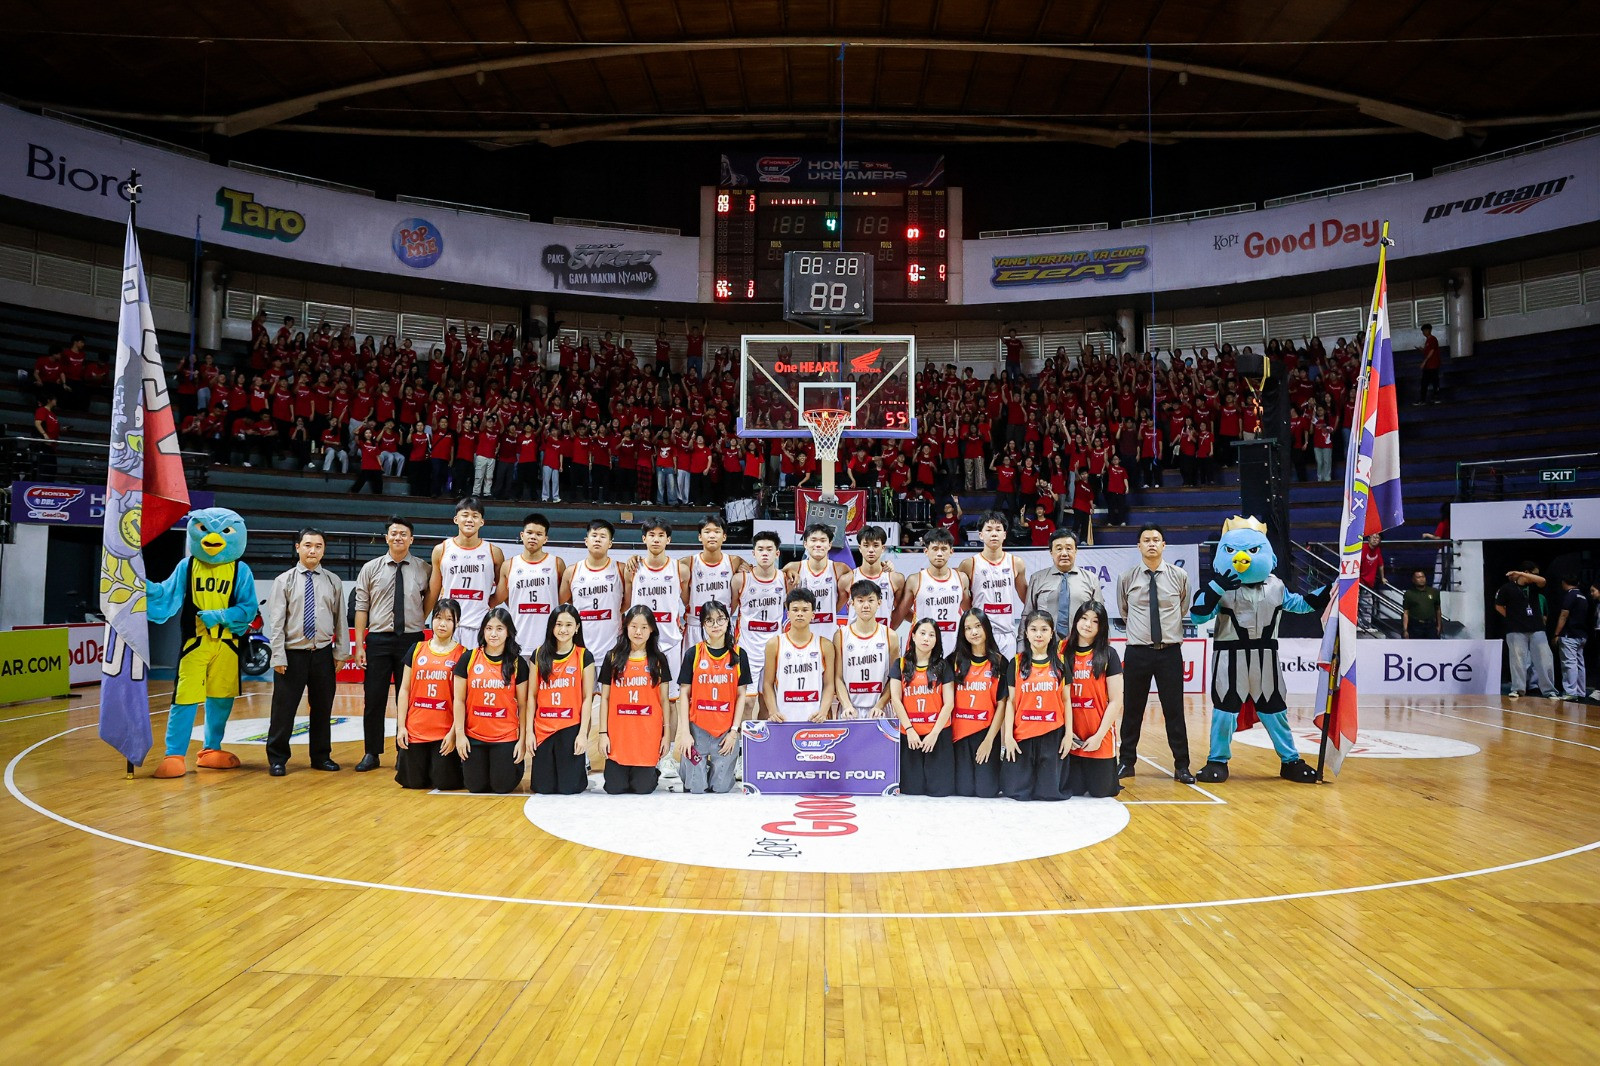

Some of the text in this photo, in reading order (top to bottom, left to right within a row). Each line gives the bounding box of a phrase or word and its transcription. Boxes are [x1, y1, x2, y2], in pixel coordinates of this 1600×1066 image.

[808, 160, 859, 170] HOME
[808, 171, 908, 180] DREAMERS
[718, 195, 729, 204] 00
[1422, 176, 1568, 224] proteam
[218, 188, 305, 238] Taro
[718, 204, 729, 212] 03
[826, 219, 836, 231] 4
[400, 226, 427, 246] POP
[907, 228, 945, 238] 07 0
[1244, 223, 1315, 260] Good
[1322, 218, 1380, 248] Day
[406, 239, 438, 258] MIE
[547, 254, 565, 264] PAKE
[568, 249, 662, 270] STREET
[994, 257, 1026, 267] YANG
[1029, 254, 1072, 265] WORTH
[1094, 250, 1110, 260] YA
[1111, 248, 1145, 258] CUMA
[910, 264, 918, 272] 17
[569, 273, 588, 284] GAYA
[590, 272, 616, 284] MAKIN
[716, 280, 727, 289] 22
[774, 361, 797, 373] One
[1542, 471, 1573, 481] EXIT
[1522, 502, 1573, 521] AQUA
[462, 577, 471, 588] 77
[529, 591, 538, 602] 15
[995, 592, 1001, 603] 13
[593, 598, 598, 609] 8
[652, 599, 657, 610] 3
[761, 610, 767, 621] 11
[938, 608, 947, 620] 22
[1, 656, 61, 676] AR.COM
[1384, 654, 1472, 682] Bioré
[860, 669, 870, 681] 19
[798, 678, 805, 690] 17
[1073, 682, 1082, 696] 77
[428, 684, 437, 697] 15
[629, 690, 638, 703] 14
[712, 687, 718, 700] 0
[484, 692, 496, 705] 22
[552, 692, 560, 705] 13
[969, 694, 976, 707] 7
[1036, 696, 1042, 709] 3
[917, 698, 926, 712] 17
[756, 770, 885, 780] FANTASTIC FOUR
